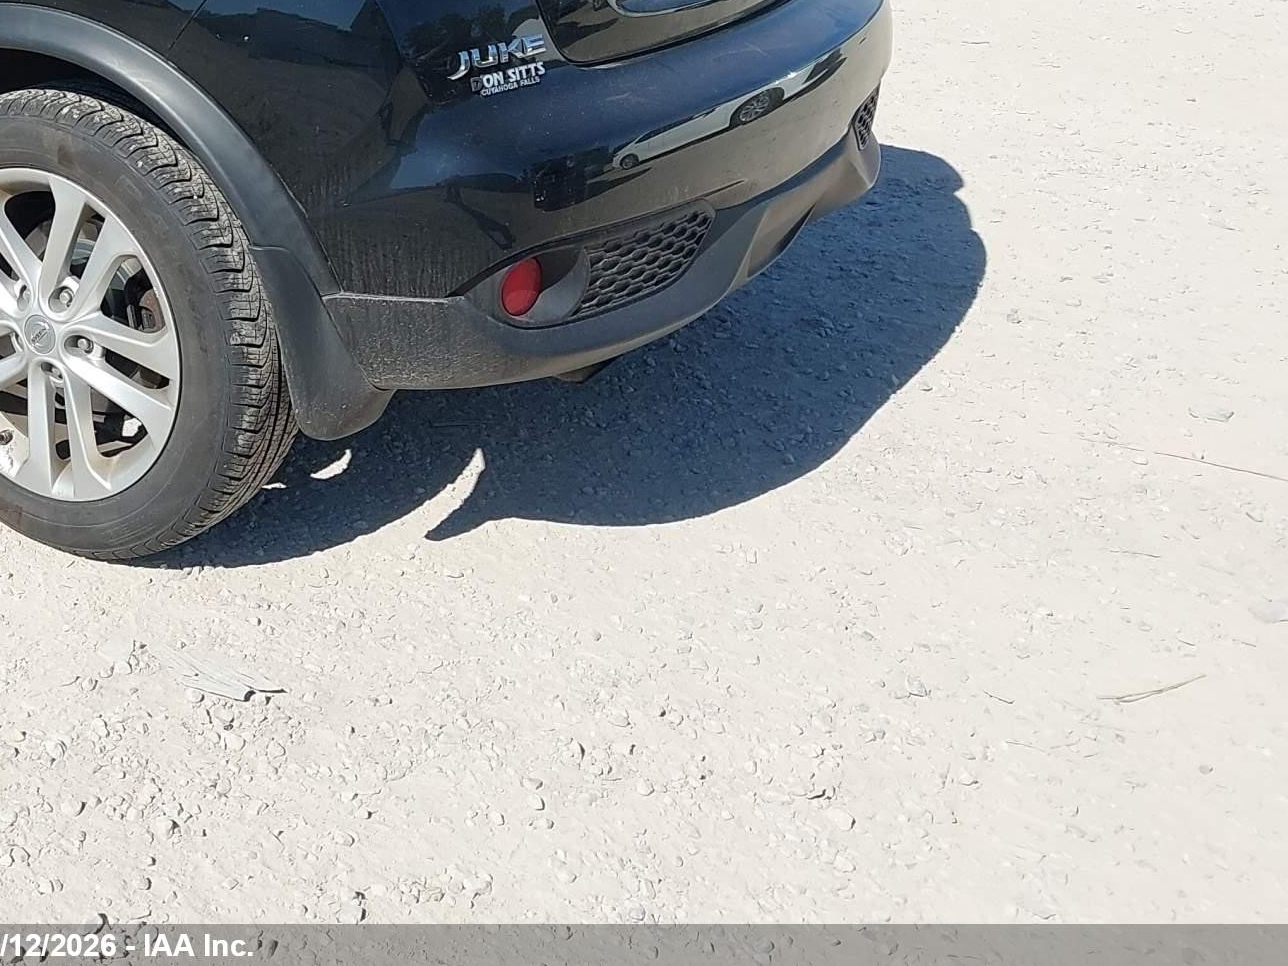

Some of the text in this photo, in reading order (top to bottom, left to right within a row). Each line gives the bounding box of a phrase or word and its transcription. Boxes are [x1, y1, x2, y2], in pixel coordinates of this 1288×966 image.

[447, 33, 546, 80] JUKE
[508, 61, 546, 83] SITTS
[480, 75, 541, 97] CUYAHOGA FALLS
